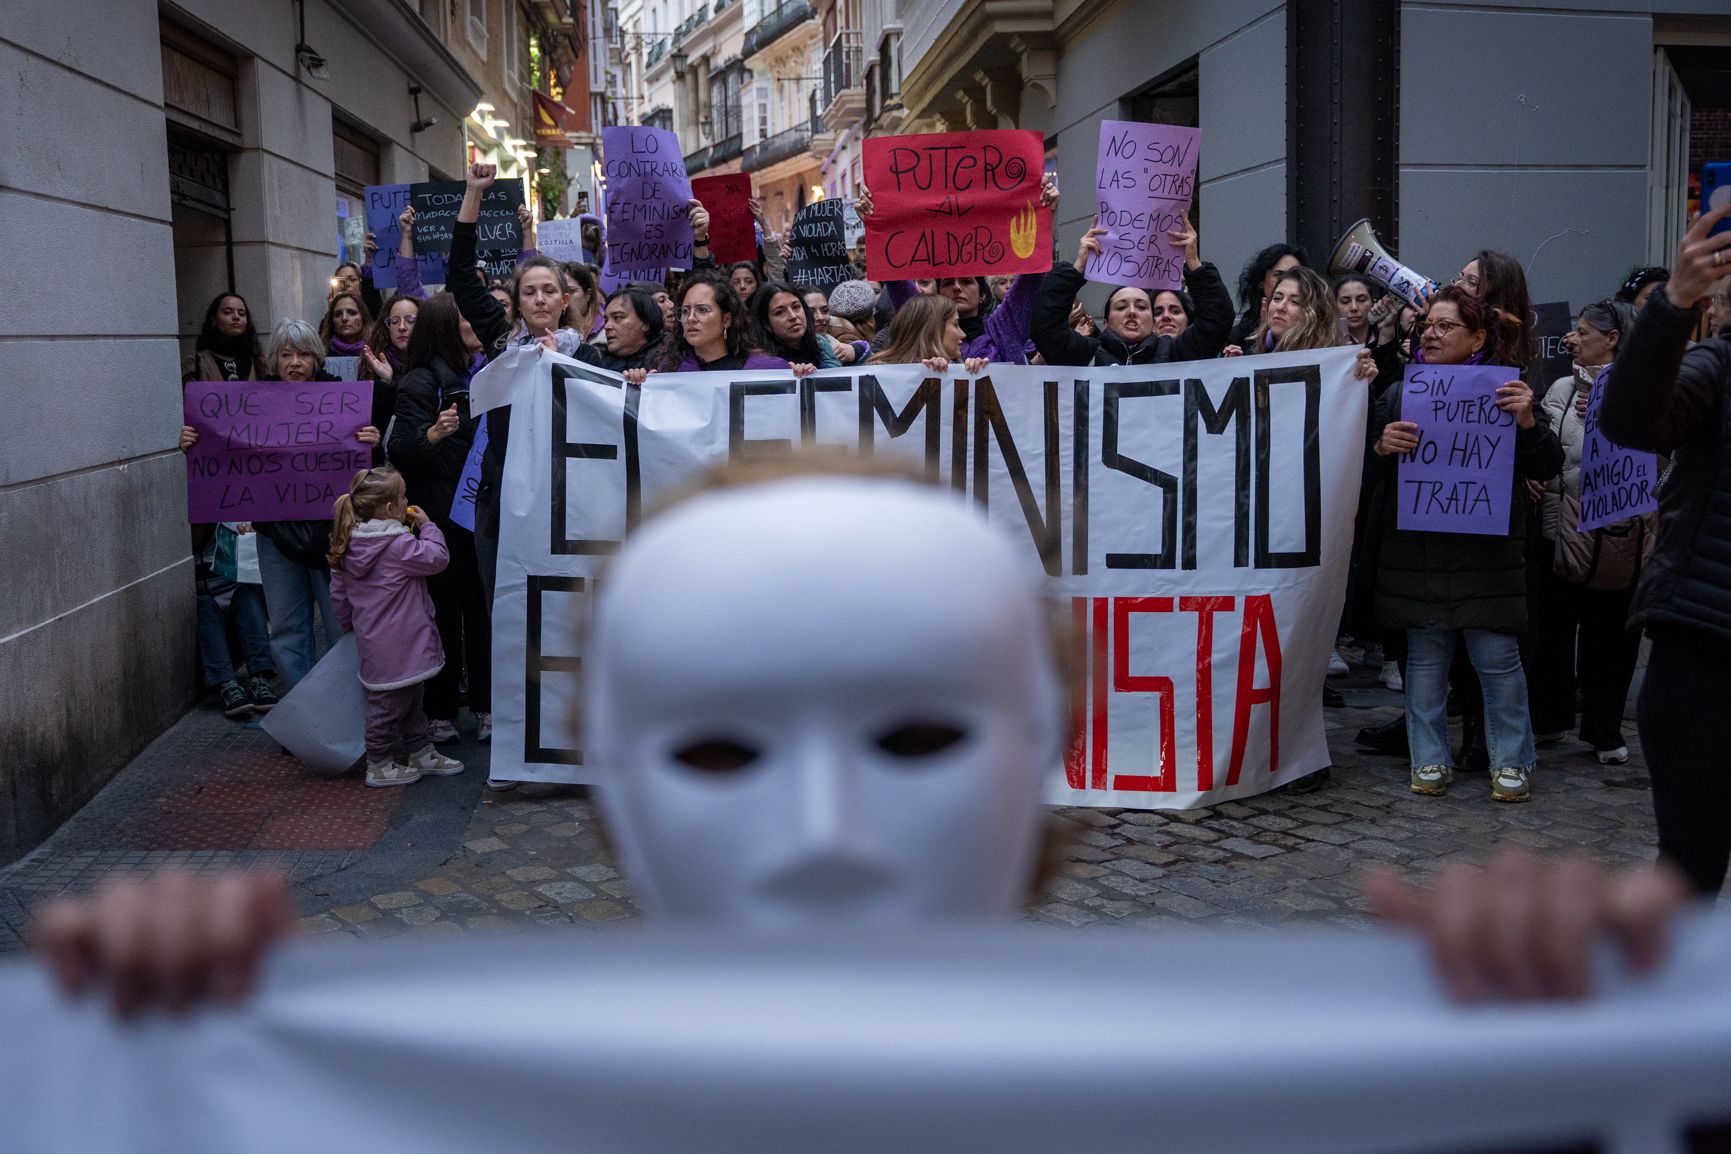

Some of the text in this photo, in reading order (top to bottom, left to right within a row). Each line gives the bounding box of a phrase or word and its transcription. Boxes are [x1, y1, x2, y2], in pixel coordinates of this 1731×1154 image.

[631, 133, 659, 154] LO
[1106, 130, 1193, 168] NO SON
[606, 158, 687, 179] CONTRARI
[642, 182, 662, 200] DE
[1098, 167, 1196, 200] LAS "OTRAS"
[371, 191, 411, 210] PUTE
[418, 191, 507, 206] TODA LAS
[810, 199, 843, 218] MUJER
[925, 195, 975, 219] AL
[477, 209, 514, 218] RECEN
[1100, 201, 1187, 233] PODEMOS
[417, 225, 436, 233] VER
[475, 222, 517, 241] LVER
[645, 224, 664, 239] ES
[798, 221, 838, 238] VIOLADA
[539, 238, 574, 247] COSTILLA
[791, 241, 849, 261] ADA 4 HORAS
[1113, 232, 1162, 254] SER
[793, 264, 852, 286] #HARTAS
[1089, 249, 1182, 283] NOSOTRAS
[200, 391, 360, 419] QUE SER
[1432, 394, 1515, 427] PUTEROS
[226, 420, 340, 449] MUJER
[1401, 430, 1501, 470] NO HAY
[192, 451, 368, 478] NO NOS CUESTE
[1637, 464, 1648, 478] EL
[219, 483, 338, 510] LA VIDA
[1404, 480, 1492, 516] TRATA
